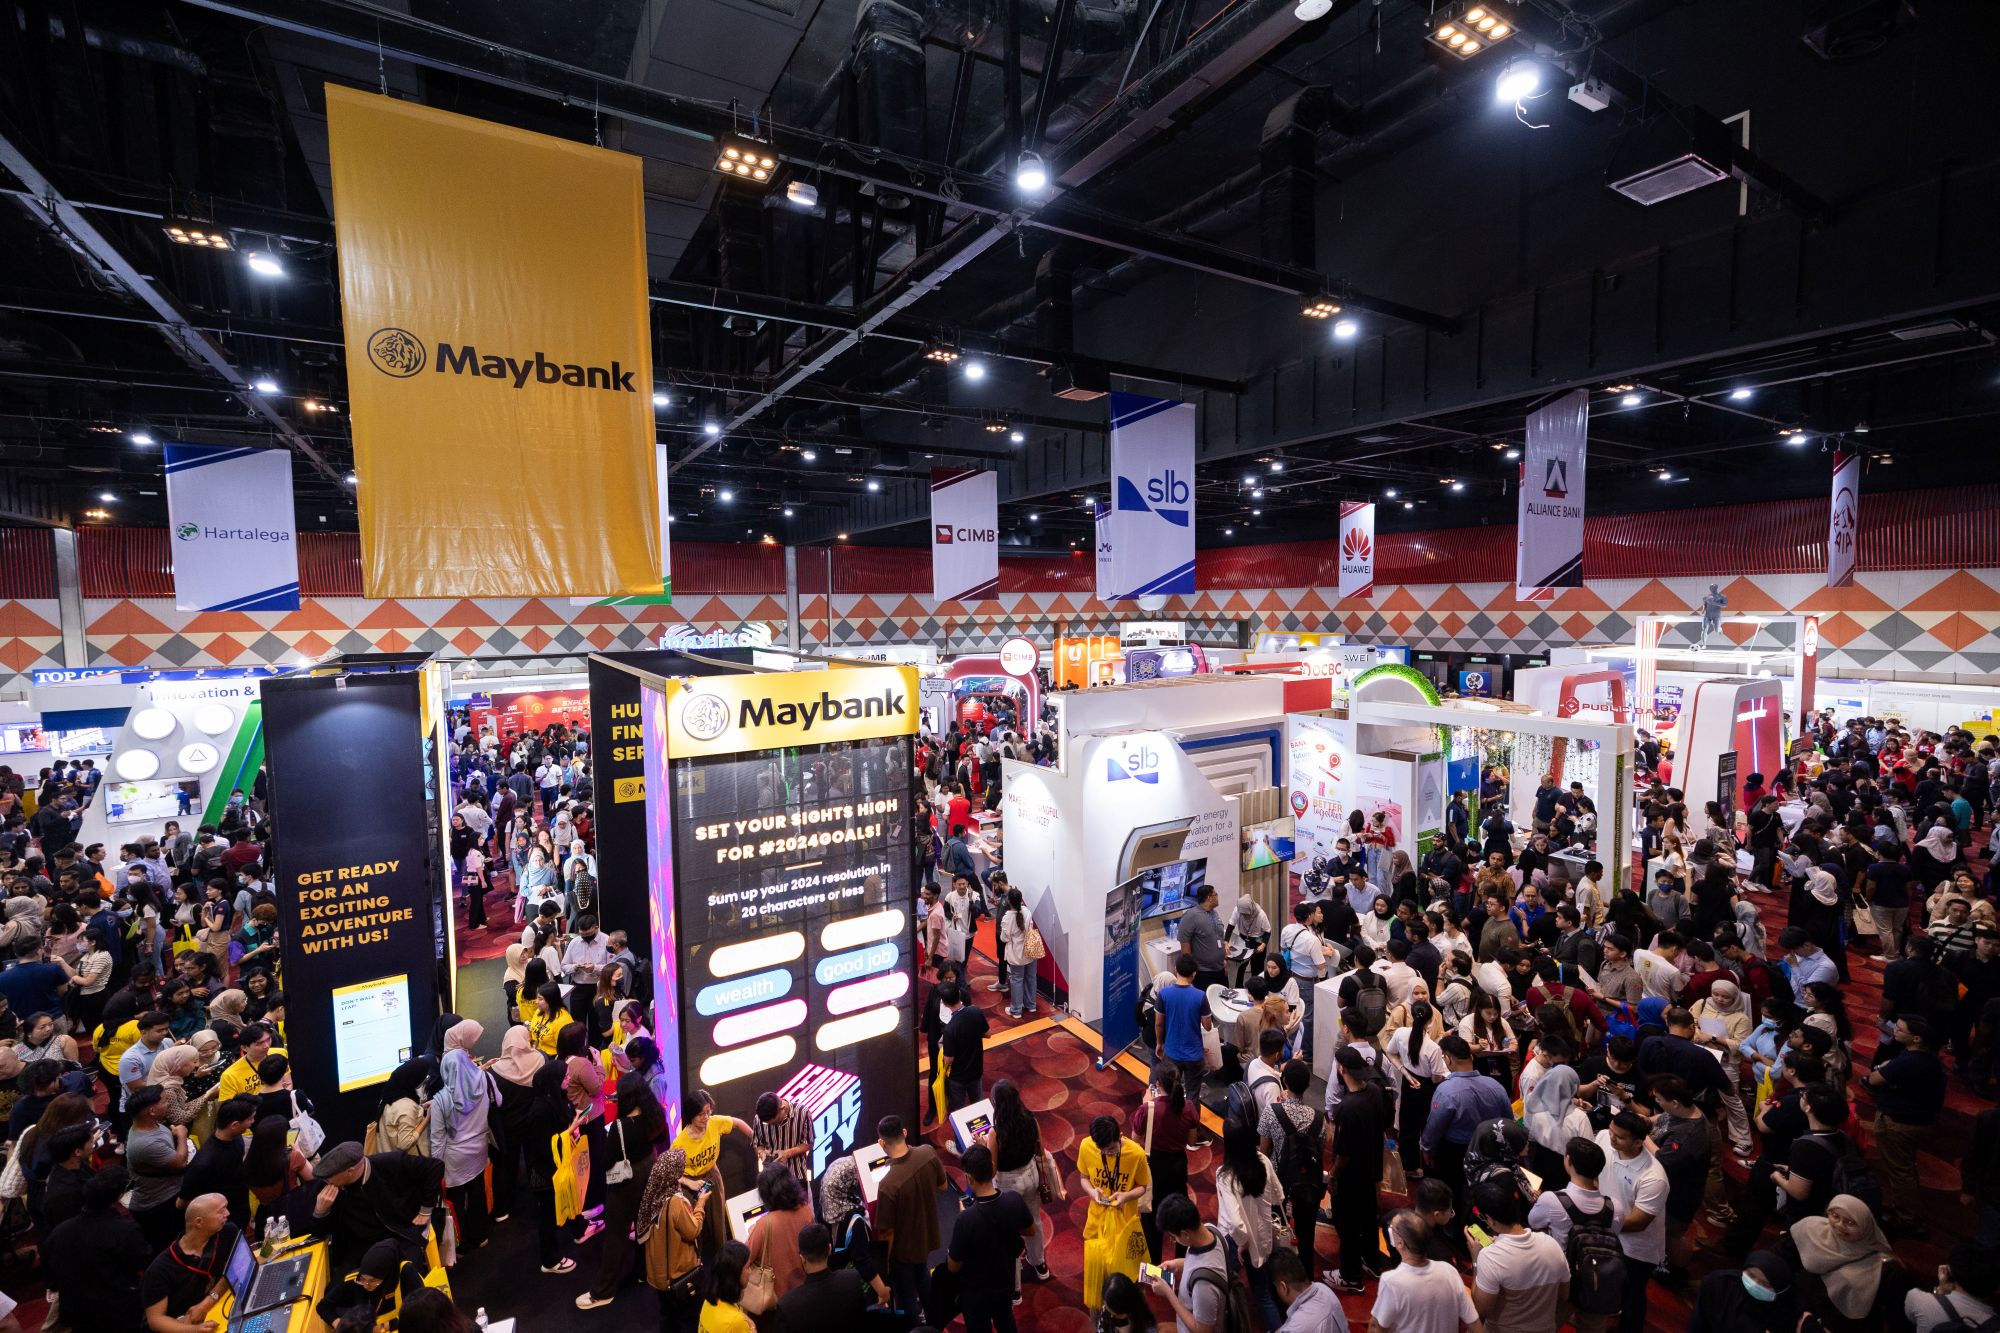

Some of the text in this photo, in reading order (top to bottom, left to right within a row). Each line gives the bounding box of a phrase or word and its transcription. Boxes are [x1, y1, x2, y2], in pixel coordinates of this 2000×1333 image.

[435, 342, 637, 392] Maybank
[1147, 469, 1190, 504] slb
[1526, 502, 1562, 517] ALLIANCE
[204, 525, 290, 543] Hartalega
[956, 528, 996, 543] CIMB
[1834, 531, 1853, 554] AIA
[1342, 565, 1371, 574] HUAWEI
[35, 672, 75, 683] TOP
[1312, 663, 1342, 676] OCBC
[243, 686, 255, 696] &
[611, 703, 643, 719] HU
[738, 688, 906, 731] Maybank
[1582, 703, 1678, 718] PUBLIC BANK
[612, 745, 645, 762] SER
[1128, 746, 1159, 772] slb
[1203, 808, 1229, 821] energy
[1312, 798, 1343, 812] BETTER
[695, 798, 898, 842] SET YOUR SIGHTS HIGH
[1215, 821, 1226, 831] for
[1227, 821, 1233, 829] a
[716, 823, 881, 864] FOR #2024GOALS!
[297, 860, 400, 886] GET READY
[298, 881, 369, 903] FOR AN
[707, 862, 892, 907] Sum up your 2024 resolution in
[299, 895, 390, 921] EXCITING
[741, 885, 865, 918] 20 characters or less
[301, 907, 413, 938] ADVENTURE
[302, 928, 389, 955] WITH US!
[823, 948, 893, 981] good job
[714, 977, 774, 1006] wealth
[1101, 1178, 1127, 1192] MVE
